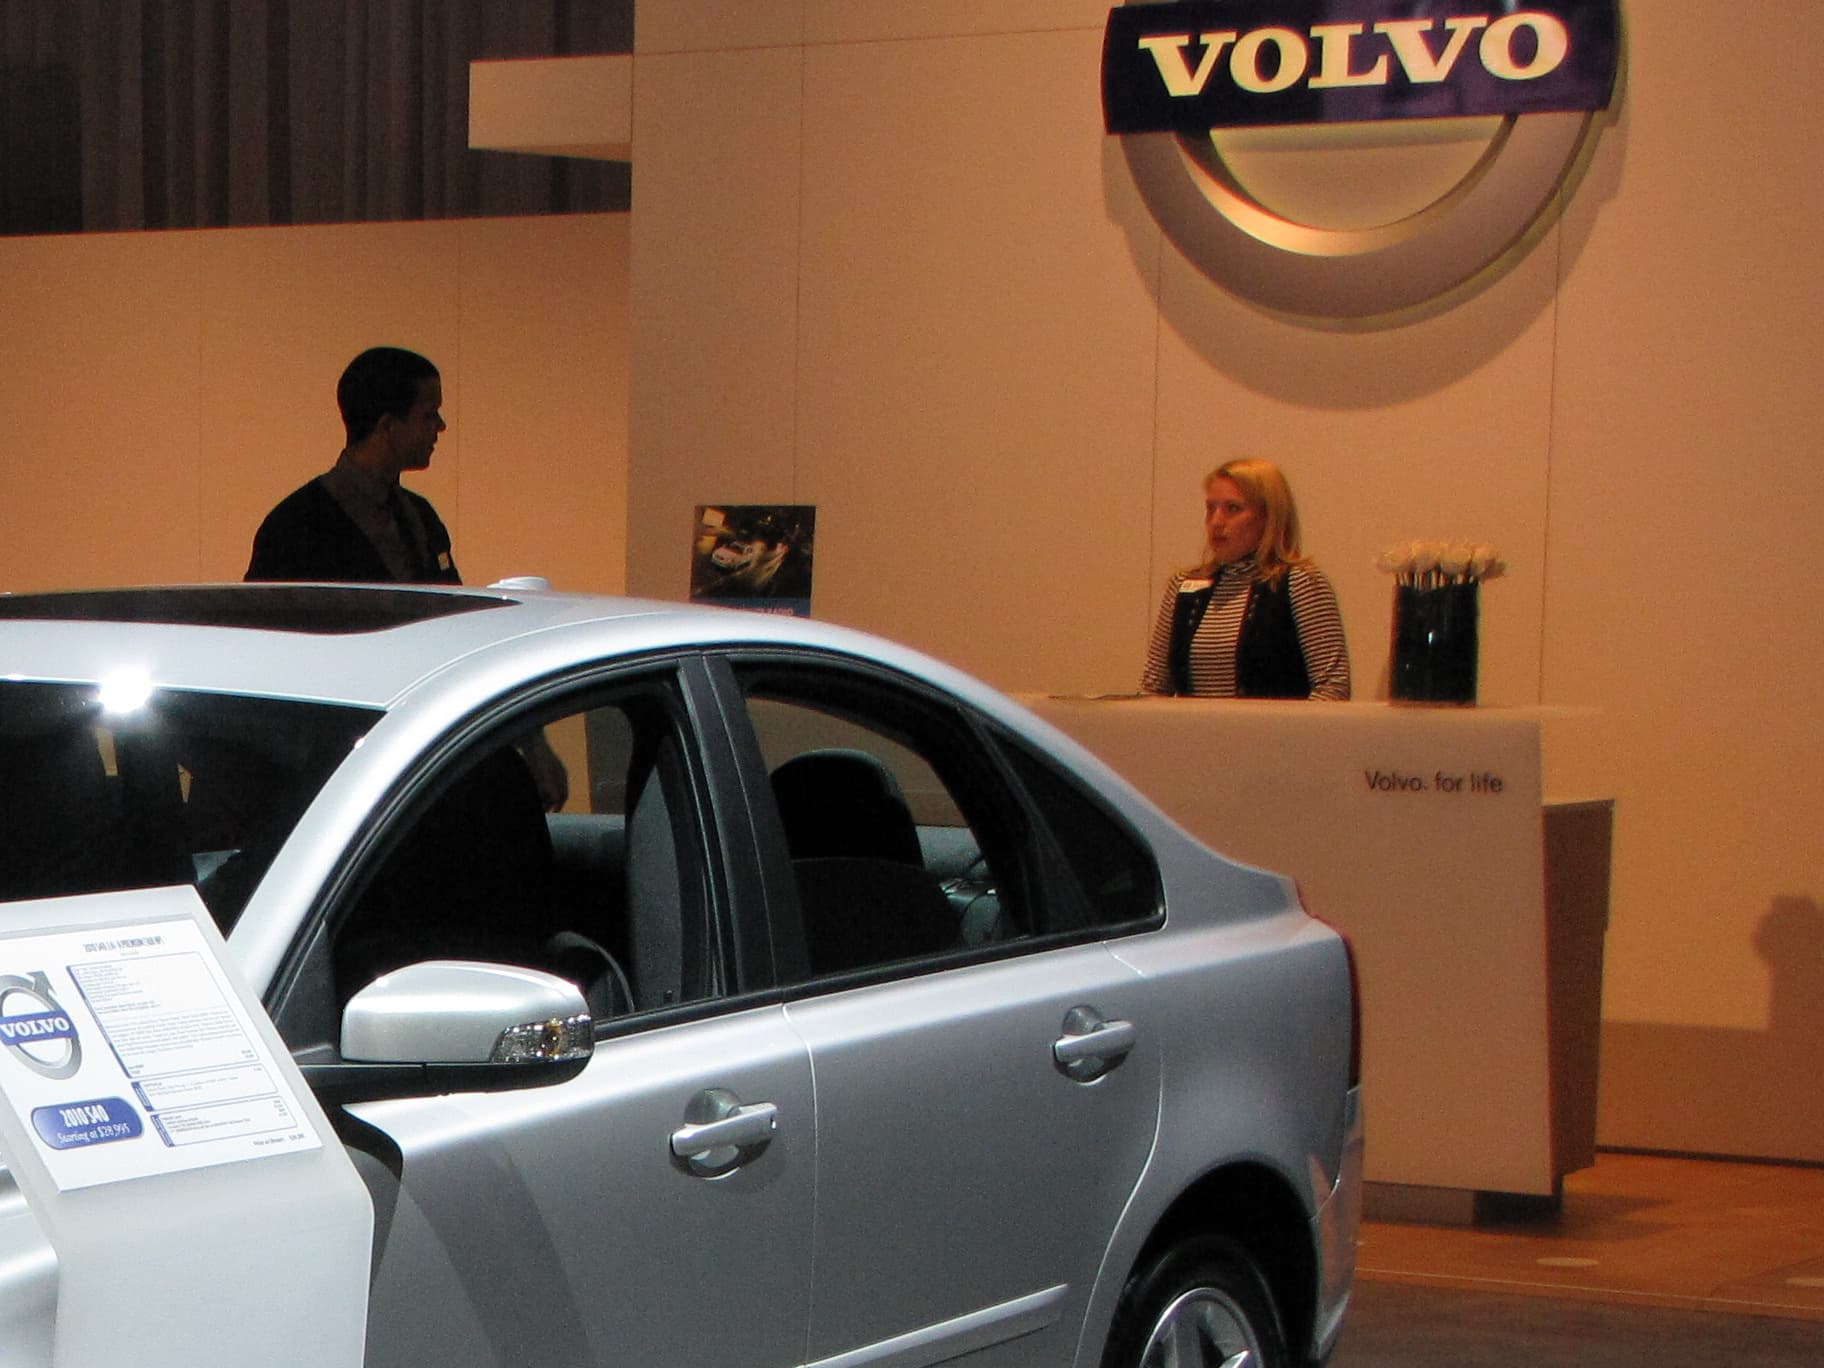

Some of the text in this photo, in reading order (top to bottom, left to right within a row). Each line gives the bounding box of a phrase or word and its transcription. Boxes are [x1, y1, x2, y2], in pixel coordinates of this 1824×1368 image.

[1138, 12, 1568, 97] VOLVO
[1364, 770, 1504, 793] Volvo. for life
[59, 1104, 111, 1128] 2010 S40
[57, 1131, 90, 1143] Starting
